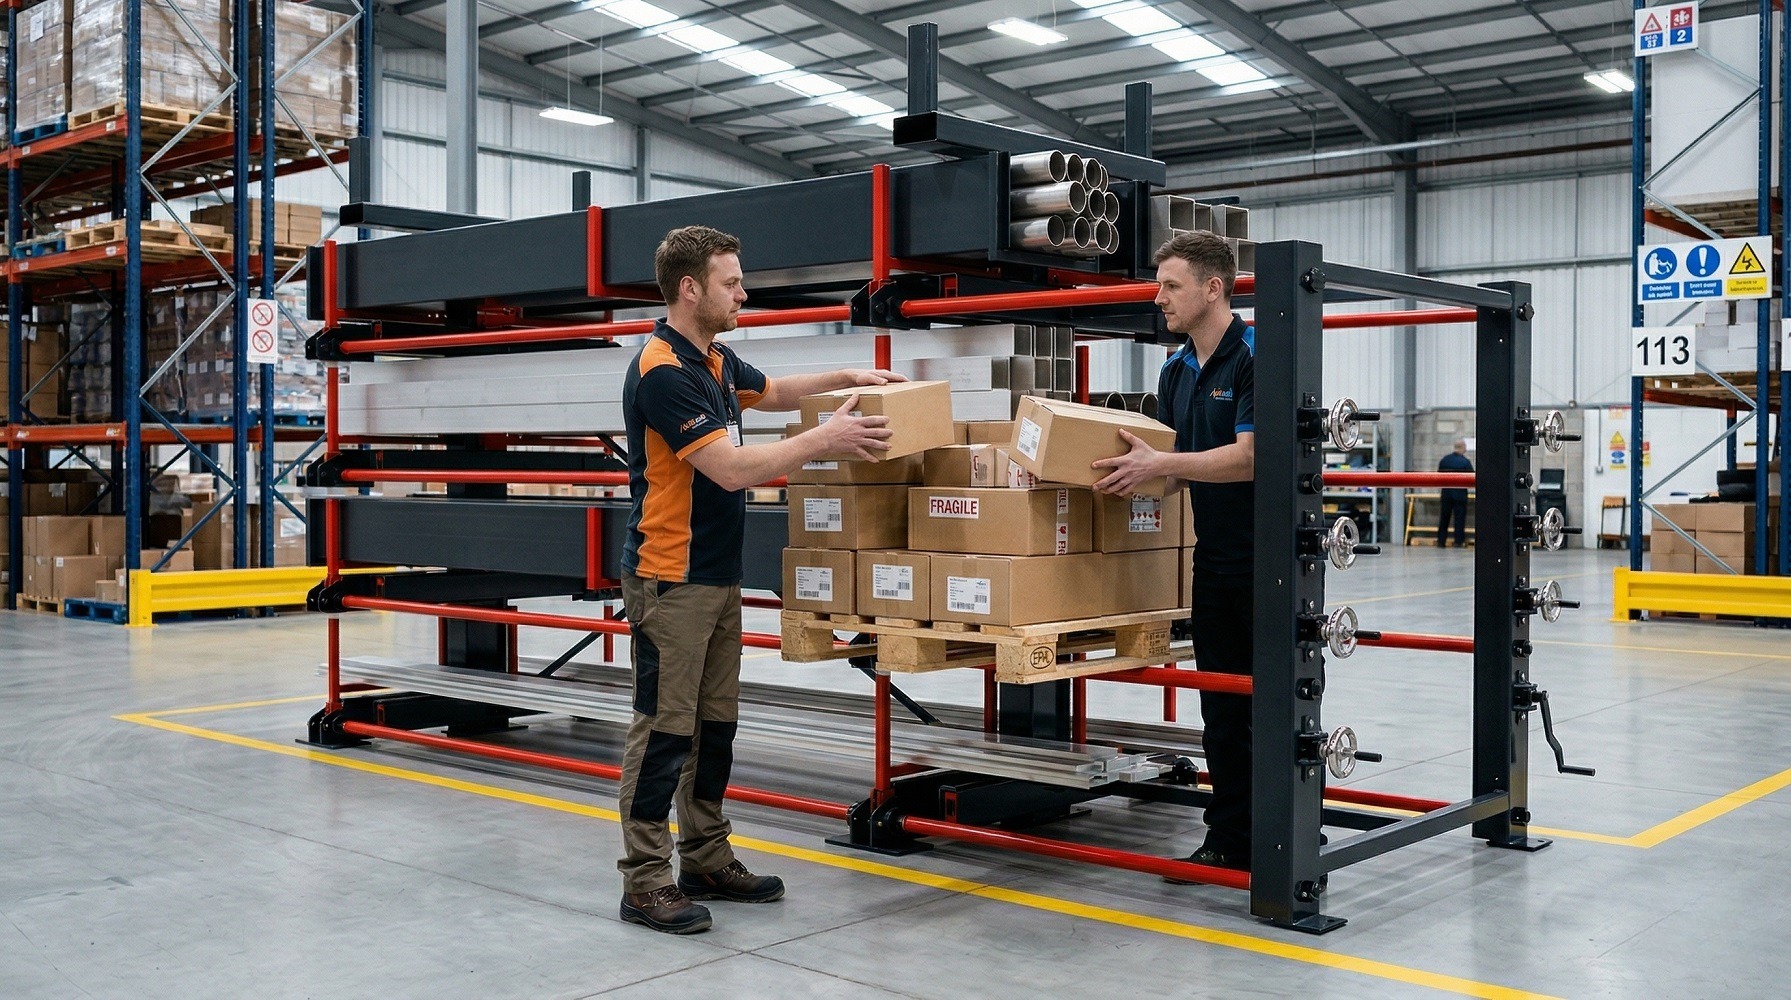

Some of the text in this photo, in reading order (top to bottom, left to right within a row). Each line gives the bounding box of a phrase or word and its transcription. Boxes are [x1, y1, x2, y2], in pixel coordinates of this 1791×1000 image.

[1677, 29, 1686, 42] 2
[1637, 335, 1690, 366] 113
[930, 499, 977, 515] FRAGILE
